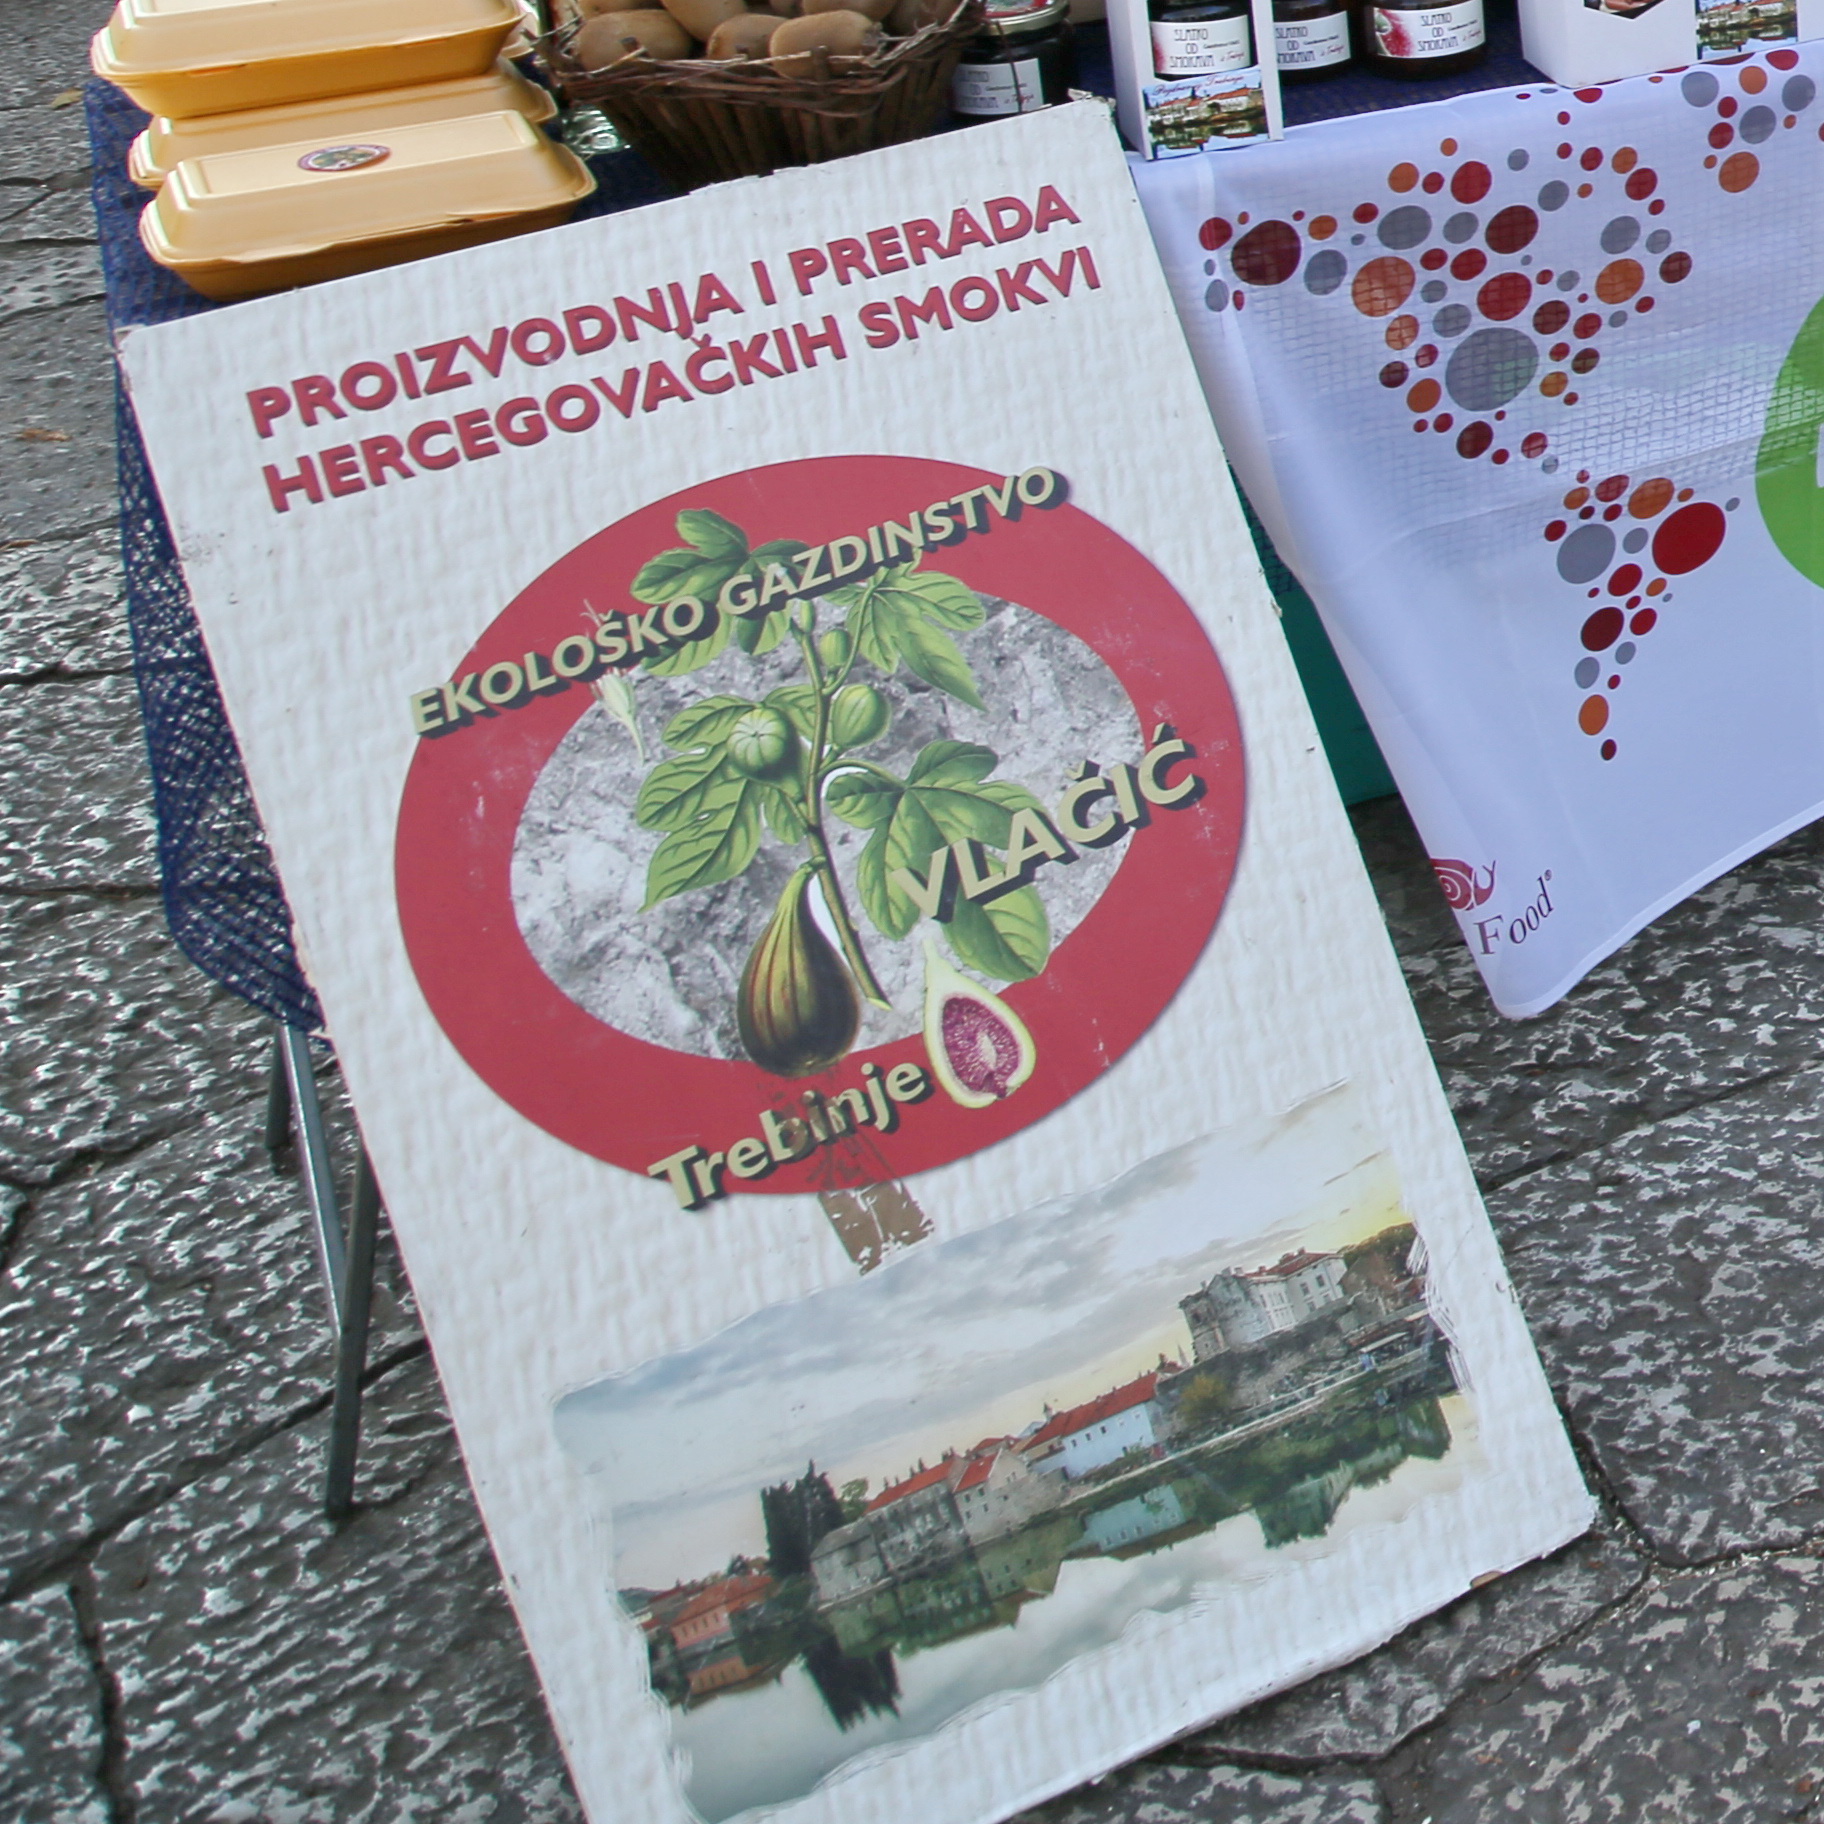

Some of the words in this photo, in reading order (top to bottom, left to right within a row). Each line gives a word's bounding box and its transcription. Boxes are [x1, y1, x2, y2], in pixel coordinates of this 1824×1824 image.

[245, 261, 743, 440] PROIZVODNJA
[753, 260, 778, 307] I
[788, 183, 1082, 300] PRERADA
[262, 315, 848, 515] HERCEGOVAČKIH
[864, 246, 1104, 347] SMOKVI
[409, 591, 706, 741] EKOLOŠKO
[718, 465, 1062, 616] GAZDINSTVO
[891, 722, 1208, 925] VLAČIĆ
[650, 1056, 930, 1211] Trebinje
